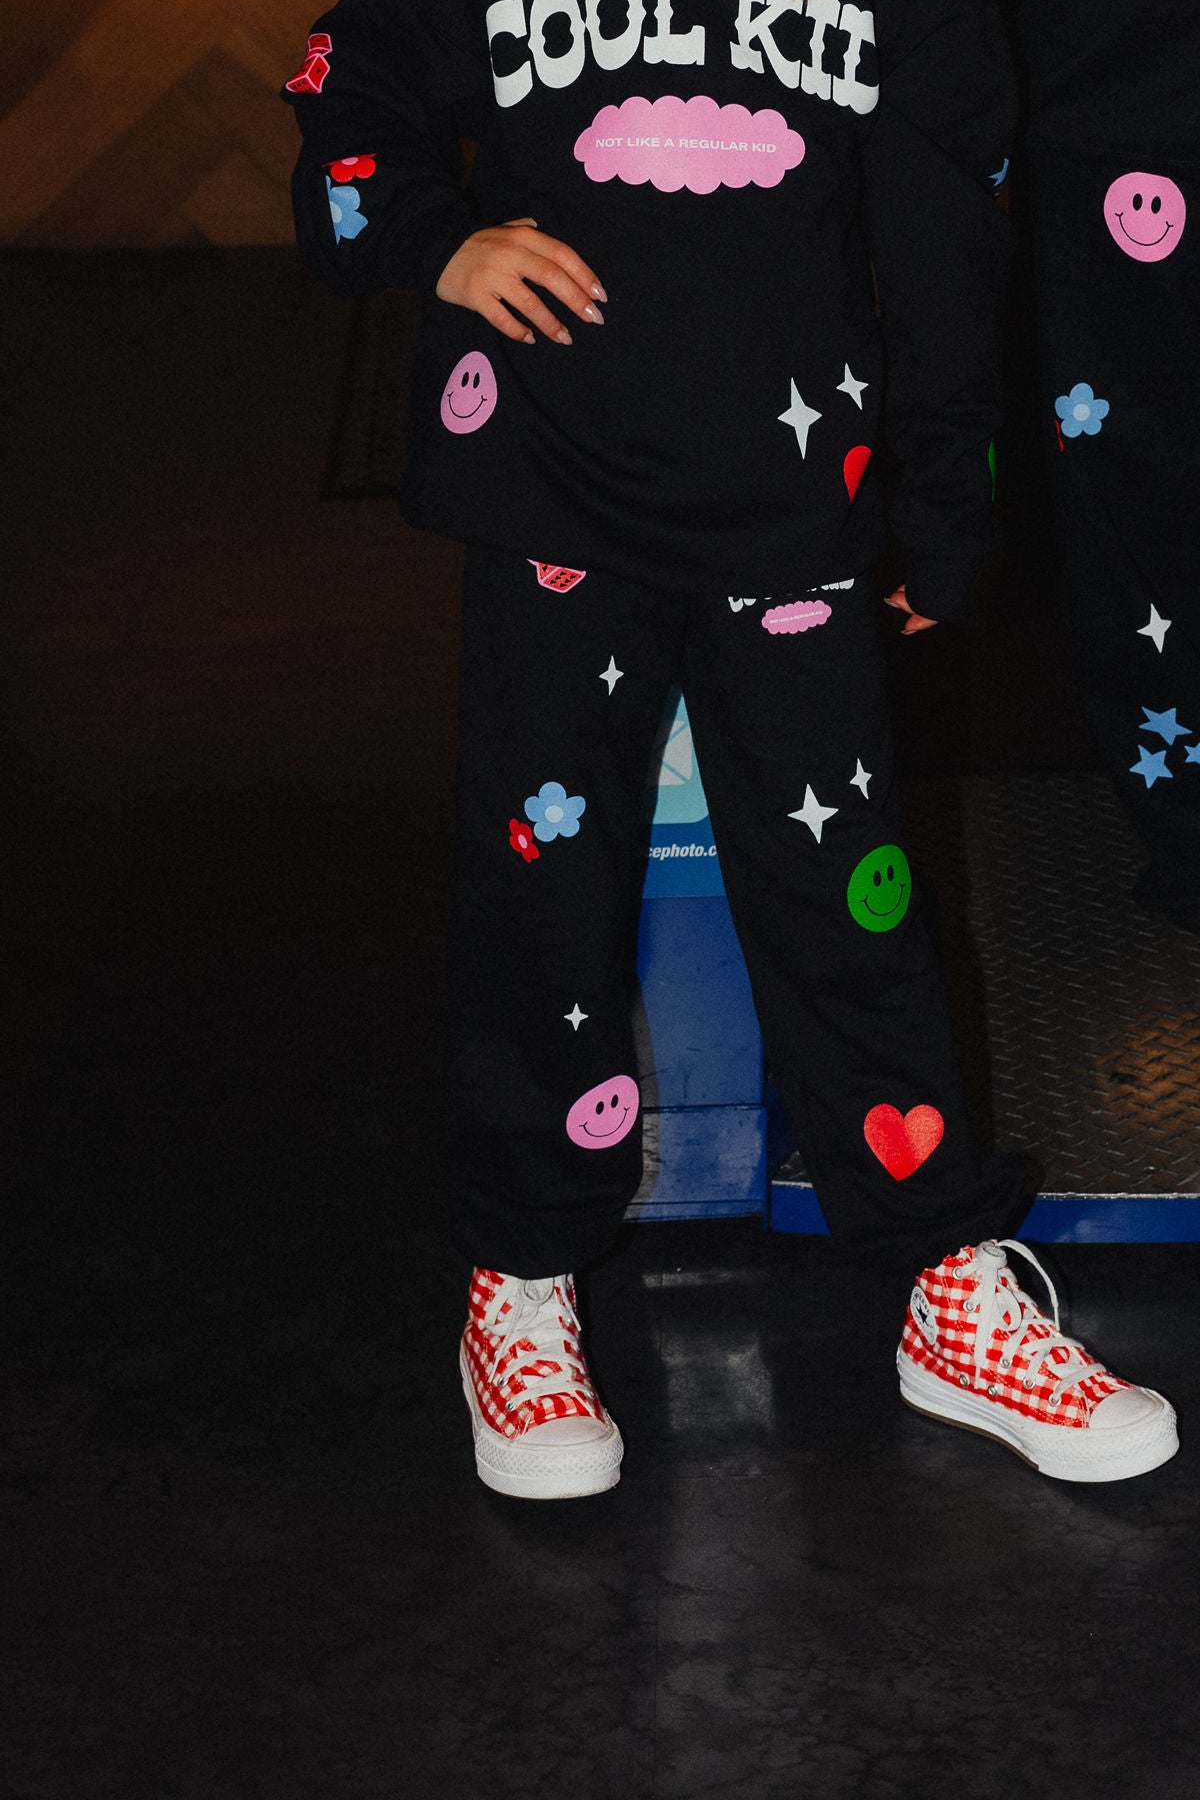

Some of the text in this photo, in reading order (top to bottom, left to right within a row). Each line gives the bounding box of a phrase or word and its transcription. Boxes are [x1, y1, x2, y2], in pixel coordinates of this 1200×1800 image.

[595, 137, 778, 153] NOT LIKE A REGULAR KID
